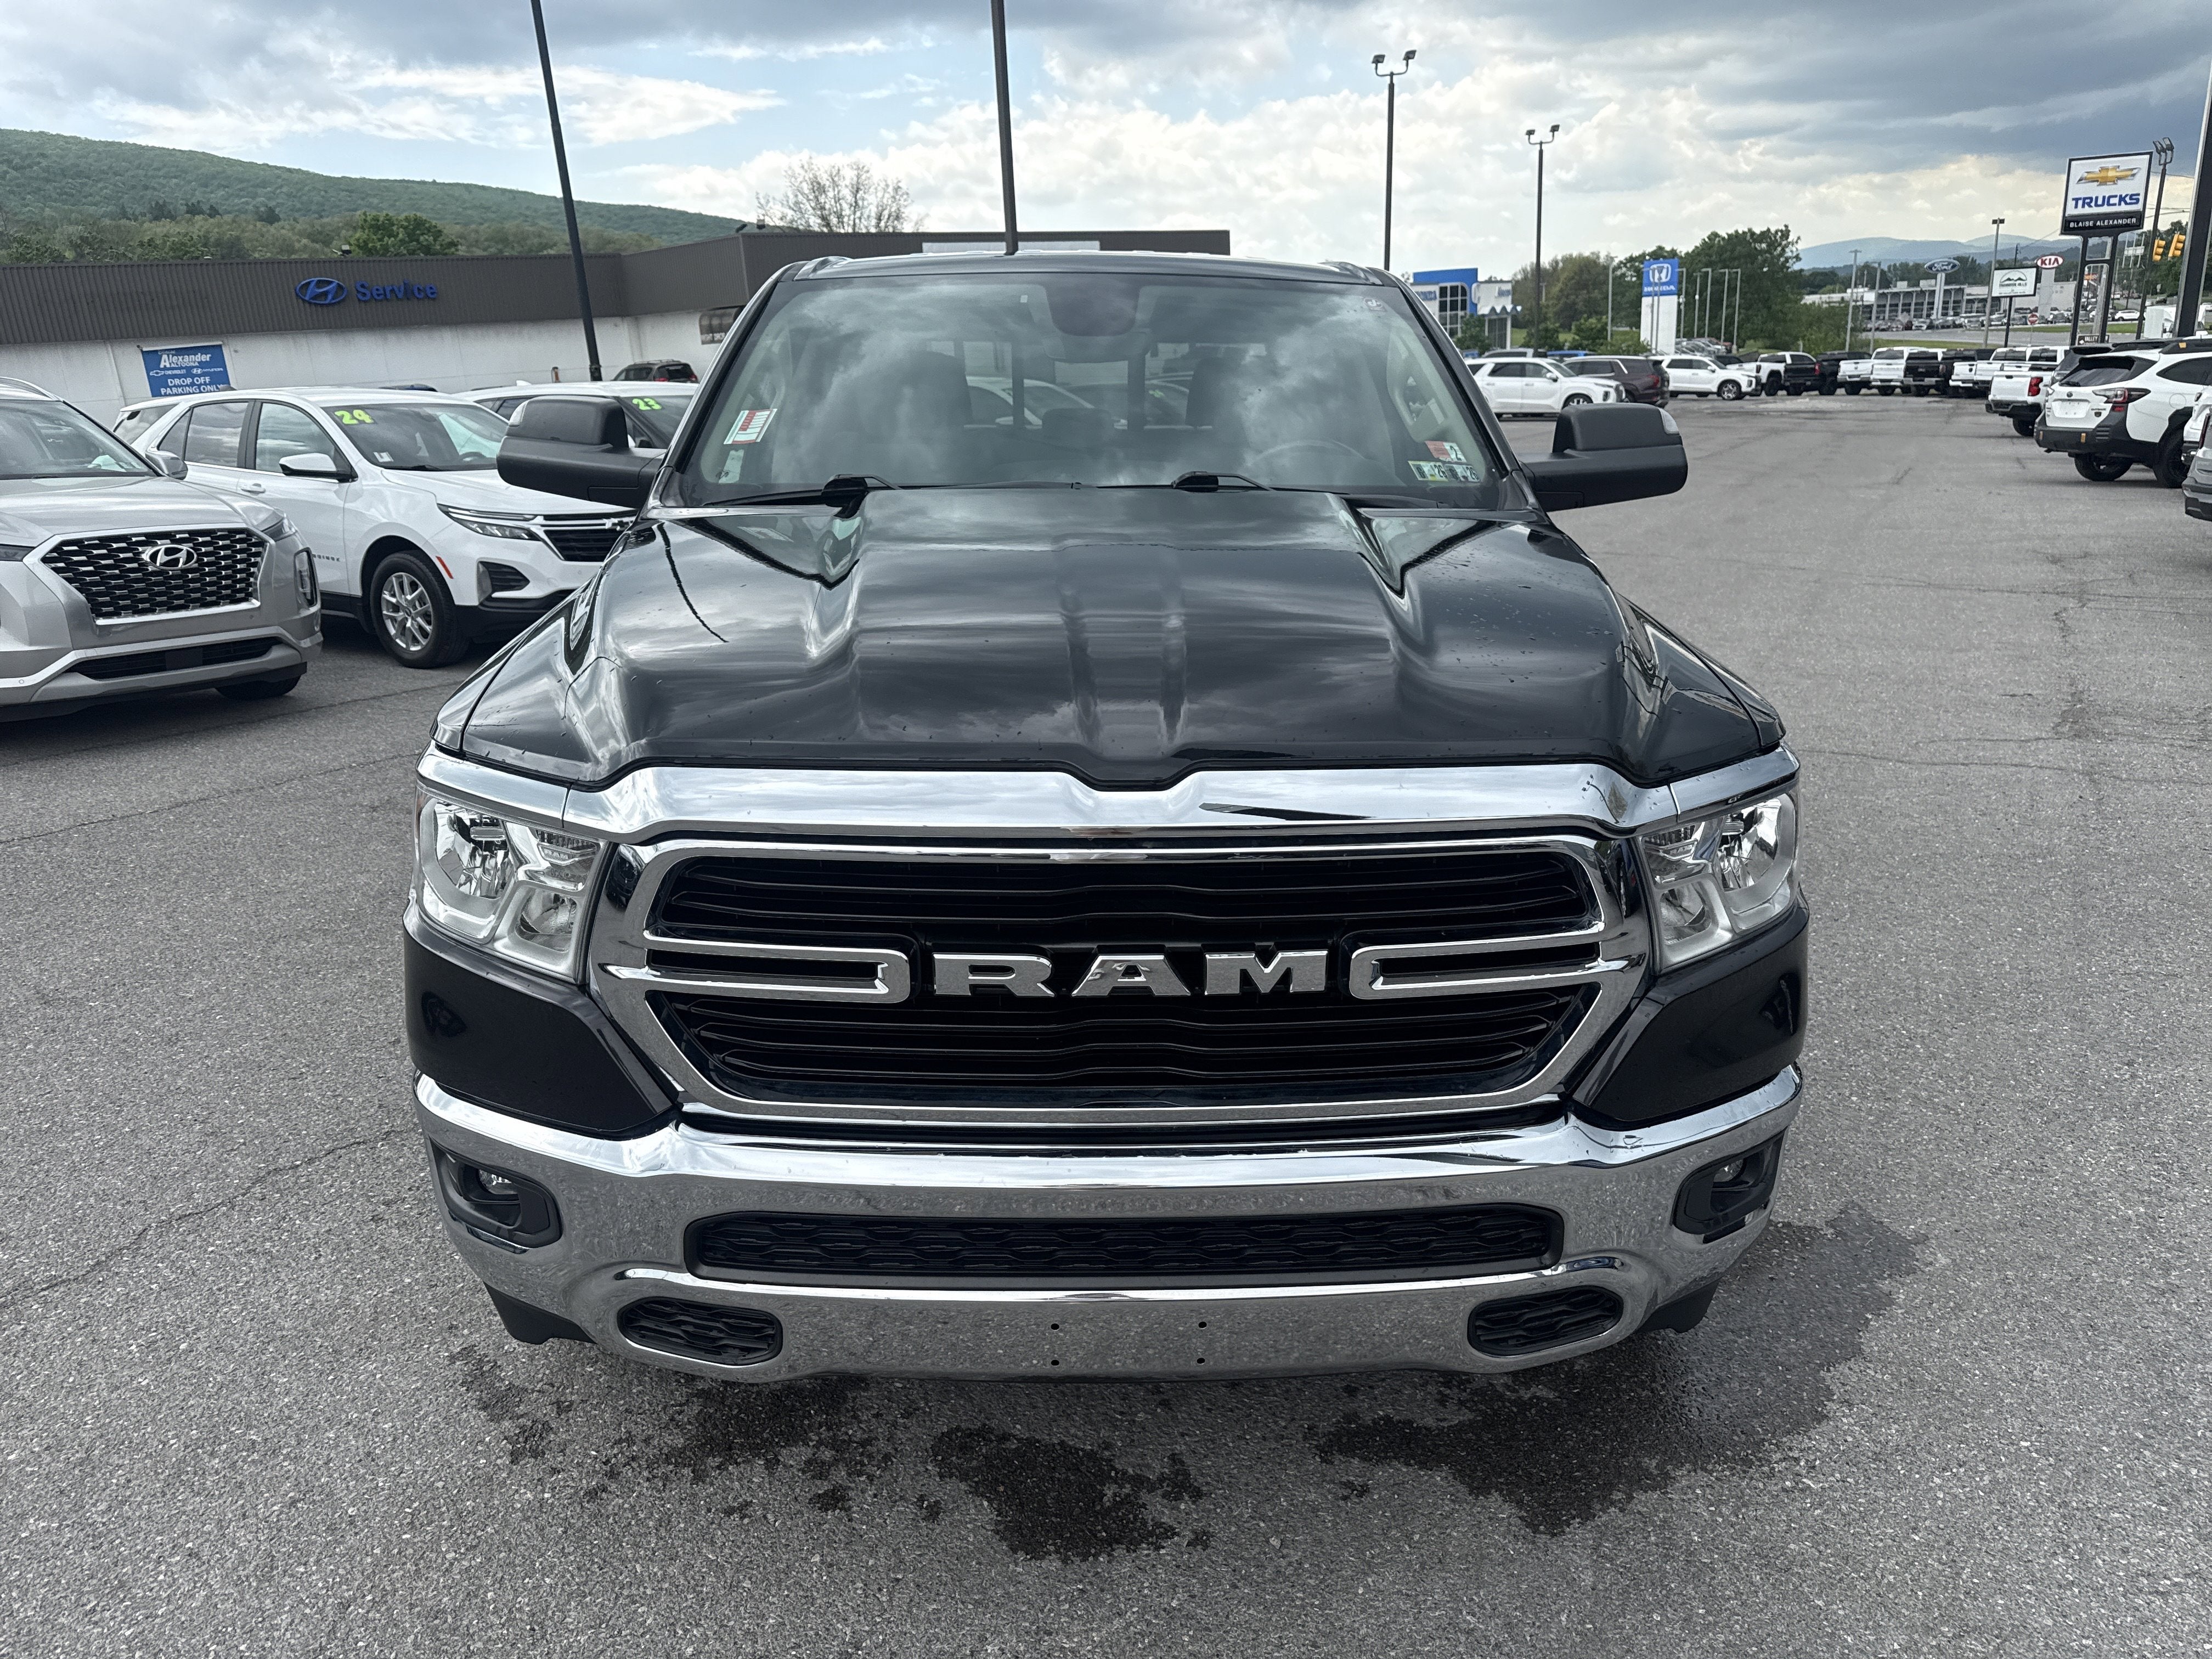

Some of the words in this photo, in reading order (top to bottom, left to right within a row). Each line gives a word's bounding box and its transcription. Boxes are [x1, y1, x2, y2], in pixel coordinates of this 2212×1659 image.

[2072, 193, 2140, 209] TRUCKS
[2096, 218, 2136, 226] ALEXANDER
[1932, 262, 1953, 272] Ford
[2041, 257, 2059, 266] KIA
[355, 279, 438, 301] Service
[160, 353, 212, 368] Alexander
[167, 377, 193, 386] DROP
[194, 376, 211, 384] OFF
[160, 386, 199, 396] PARKING
[632, 398, 662, 410] 23
[334, 409, 374, 425] 24
[933, 950, 1328, 997] RAM
